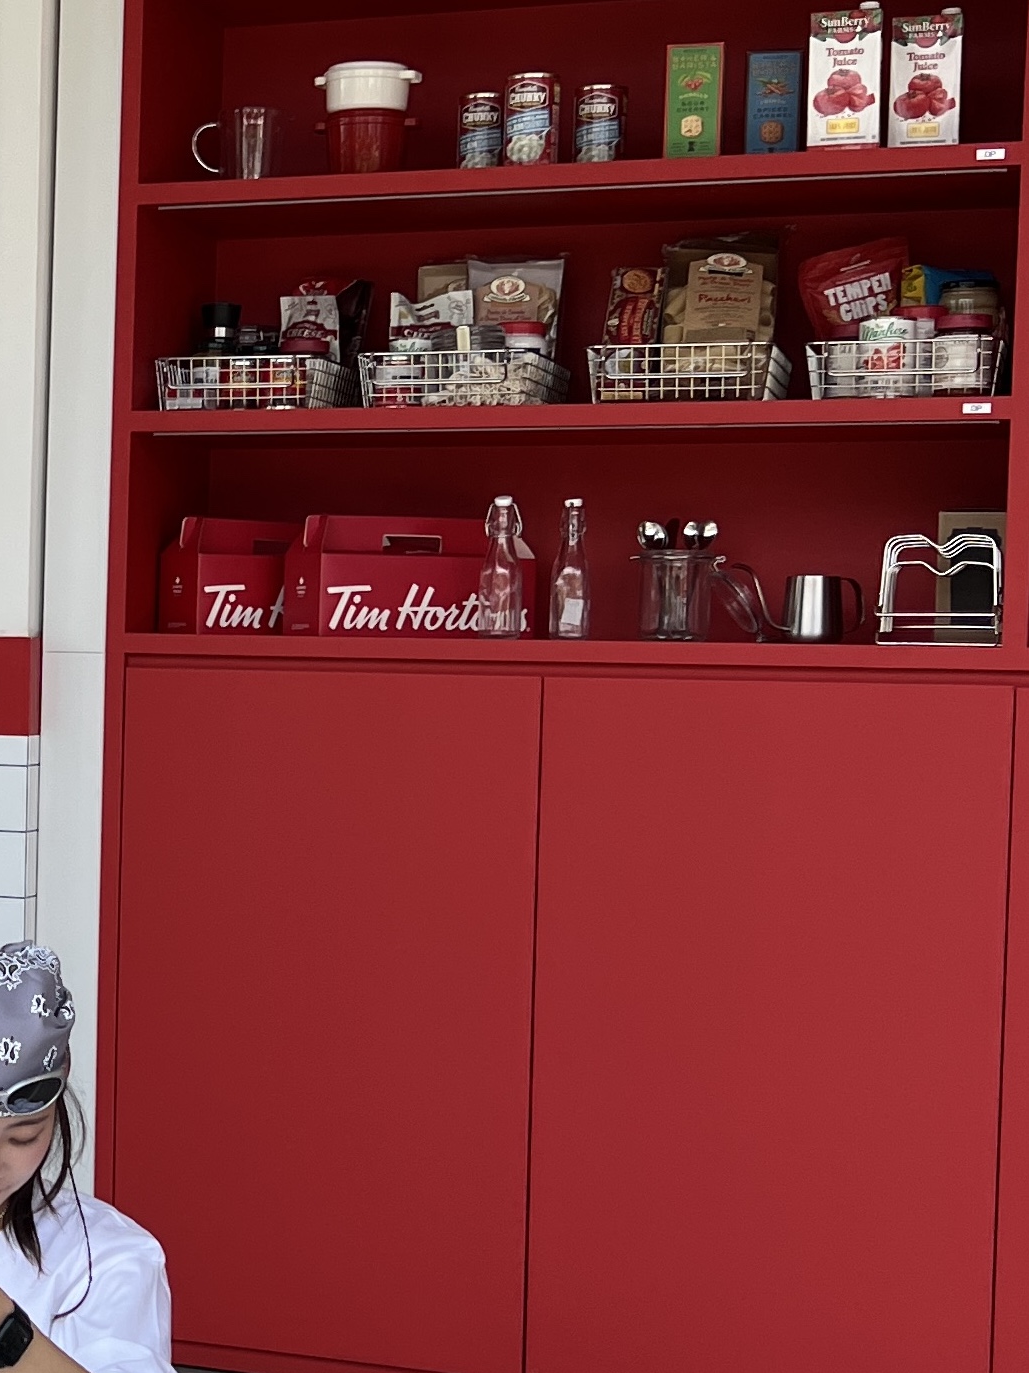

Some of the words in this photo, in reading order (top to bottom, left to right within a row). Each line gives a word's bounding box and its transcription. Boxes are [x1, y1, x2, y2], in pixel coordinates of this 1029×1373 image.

[820, 16, 870, 28] SunBerry
[901, 21, 952, 33] SunBerry
[825, 47, 865, 57] Tomato
[906, 52, 946, 62] Tomato
[832, 57, 858, 68] Juice
[913, 61, 939, 73] Juice
[823, 272, 892, 307] TEMPEH
[203, 584, 264, 630] Tim
[326, 583, 391, 631] Tim
